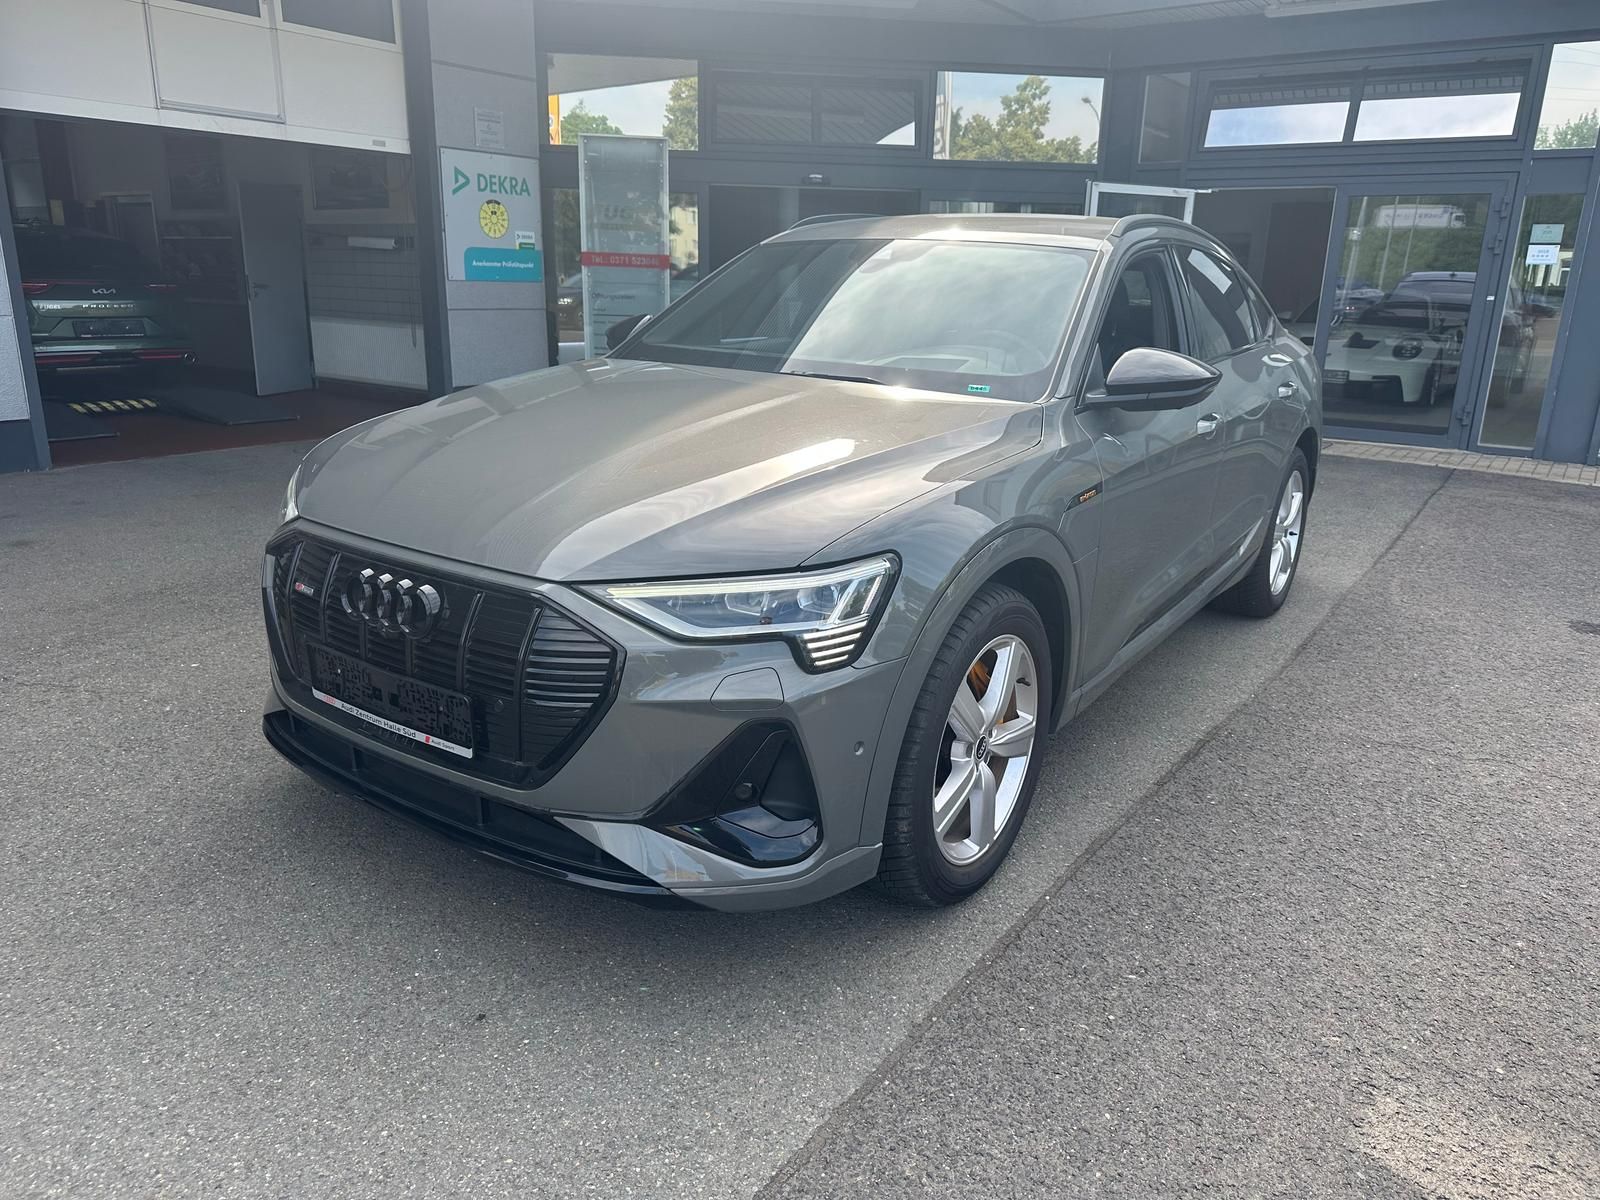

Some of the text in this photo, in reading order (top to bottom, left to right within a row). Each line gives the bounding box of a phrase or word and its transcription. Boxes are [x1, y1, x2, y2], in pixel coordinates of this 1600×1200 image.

[477, 173, 531, 196] DEKRA
[610, 255, 629, 264] 0371
[341, 703, 416, 738] Audi Zentrum Halle Süd
